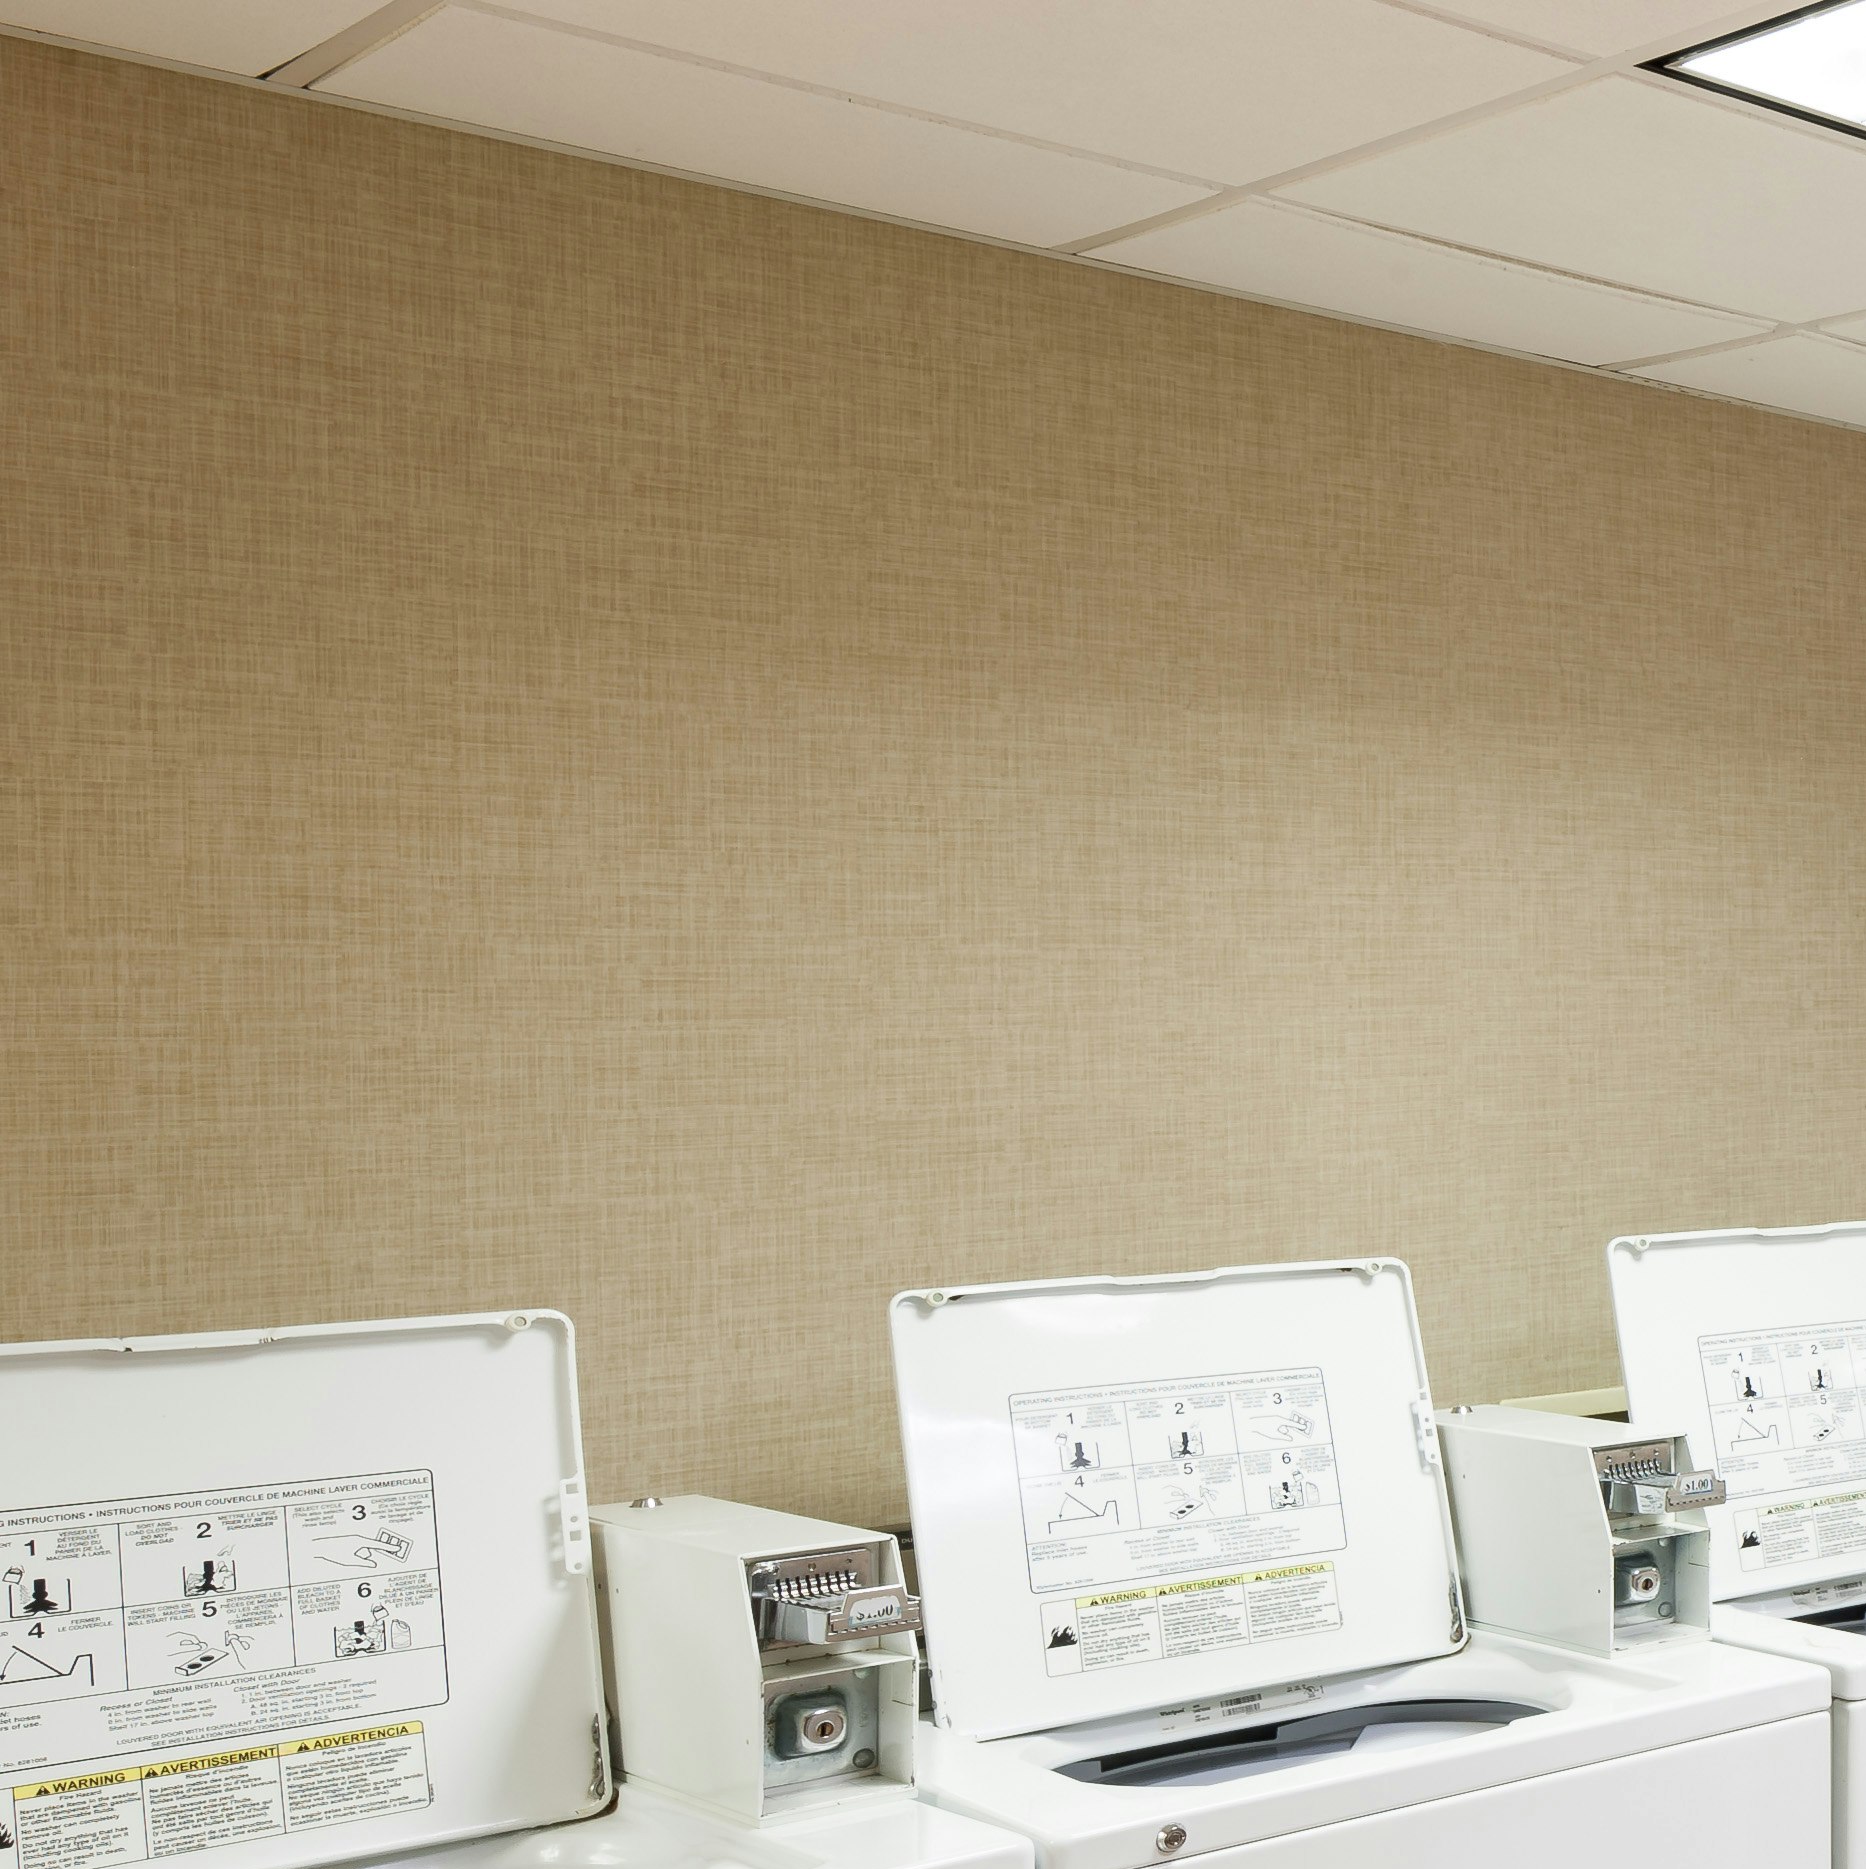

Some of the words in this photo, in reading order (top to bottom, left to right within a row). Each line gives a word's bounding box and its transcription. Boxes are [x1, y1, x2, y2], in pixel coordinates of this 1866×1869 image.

[1737, 1352, 1743, 1362] 1
[1810, 1344, 1818, 1354] 2
[1272, 1392, 1282, 1404] 3
[1819, 1395, 1827, 1405] 5
[1174, 1402, 1184, 1414] 2
[1746, 1404, 1753, 1413] 4
[1066, 1412, 1073, 1424] 1
[1281, 1451, 1291, 1464] 6
[1182, 1462, 1193, 1474] 5
[1073, 1474, 1084, 1487] 4
[7, 1511, 85, 1527] INSTRUCTIONS
[96, 1503, 171, 1517] INSTRUCTIONS
[174, 1499, 201, 1509] POUR
[204, 1493, 263, 1506] COUVERCLE
[266, 1492, 279, 1500] DE
[282, 1487, 325, 1498] MACHINE
[328, 1484, 357, 1493] LAVER
[360, 1476, 428, 1490] COMMERCIALE
[351, 1504, 366, 1521] 3
[195, 1521, 212, 1538] 2
[23, 1539, 35, 1556] 1
[1265, 1564, 1324, 1579] ADVERTENCIA
[356, 1581, 371, 1598] 6
[1168, 1576, 1241, 1594] AVERTISSEMENT
[1100, 1590, 1146, 1604] WARNING
[201, 1600, 217, 1618] 5
[27, 1621, 45, 1639] 4
[152, 1685, 192, 1696] MINIMUM
[194, 1676, 255, 1690] INSTALLATION
[258, 1667, 316, 1681] CLEARANCES
[312, 1725, 408, 1749] ADVERTENCIA
[160, 1747, 276, 1775] AVERTISSEMENT
[52, 1772, 125, 1793] WARNING
